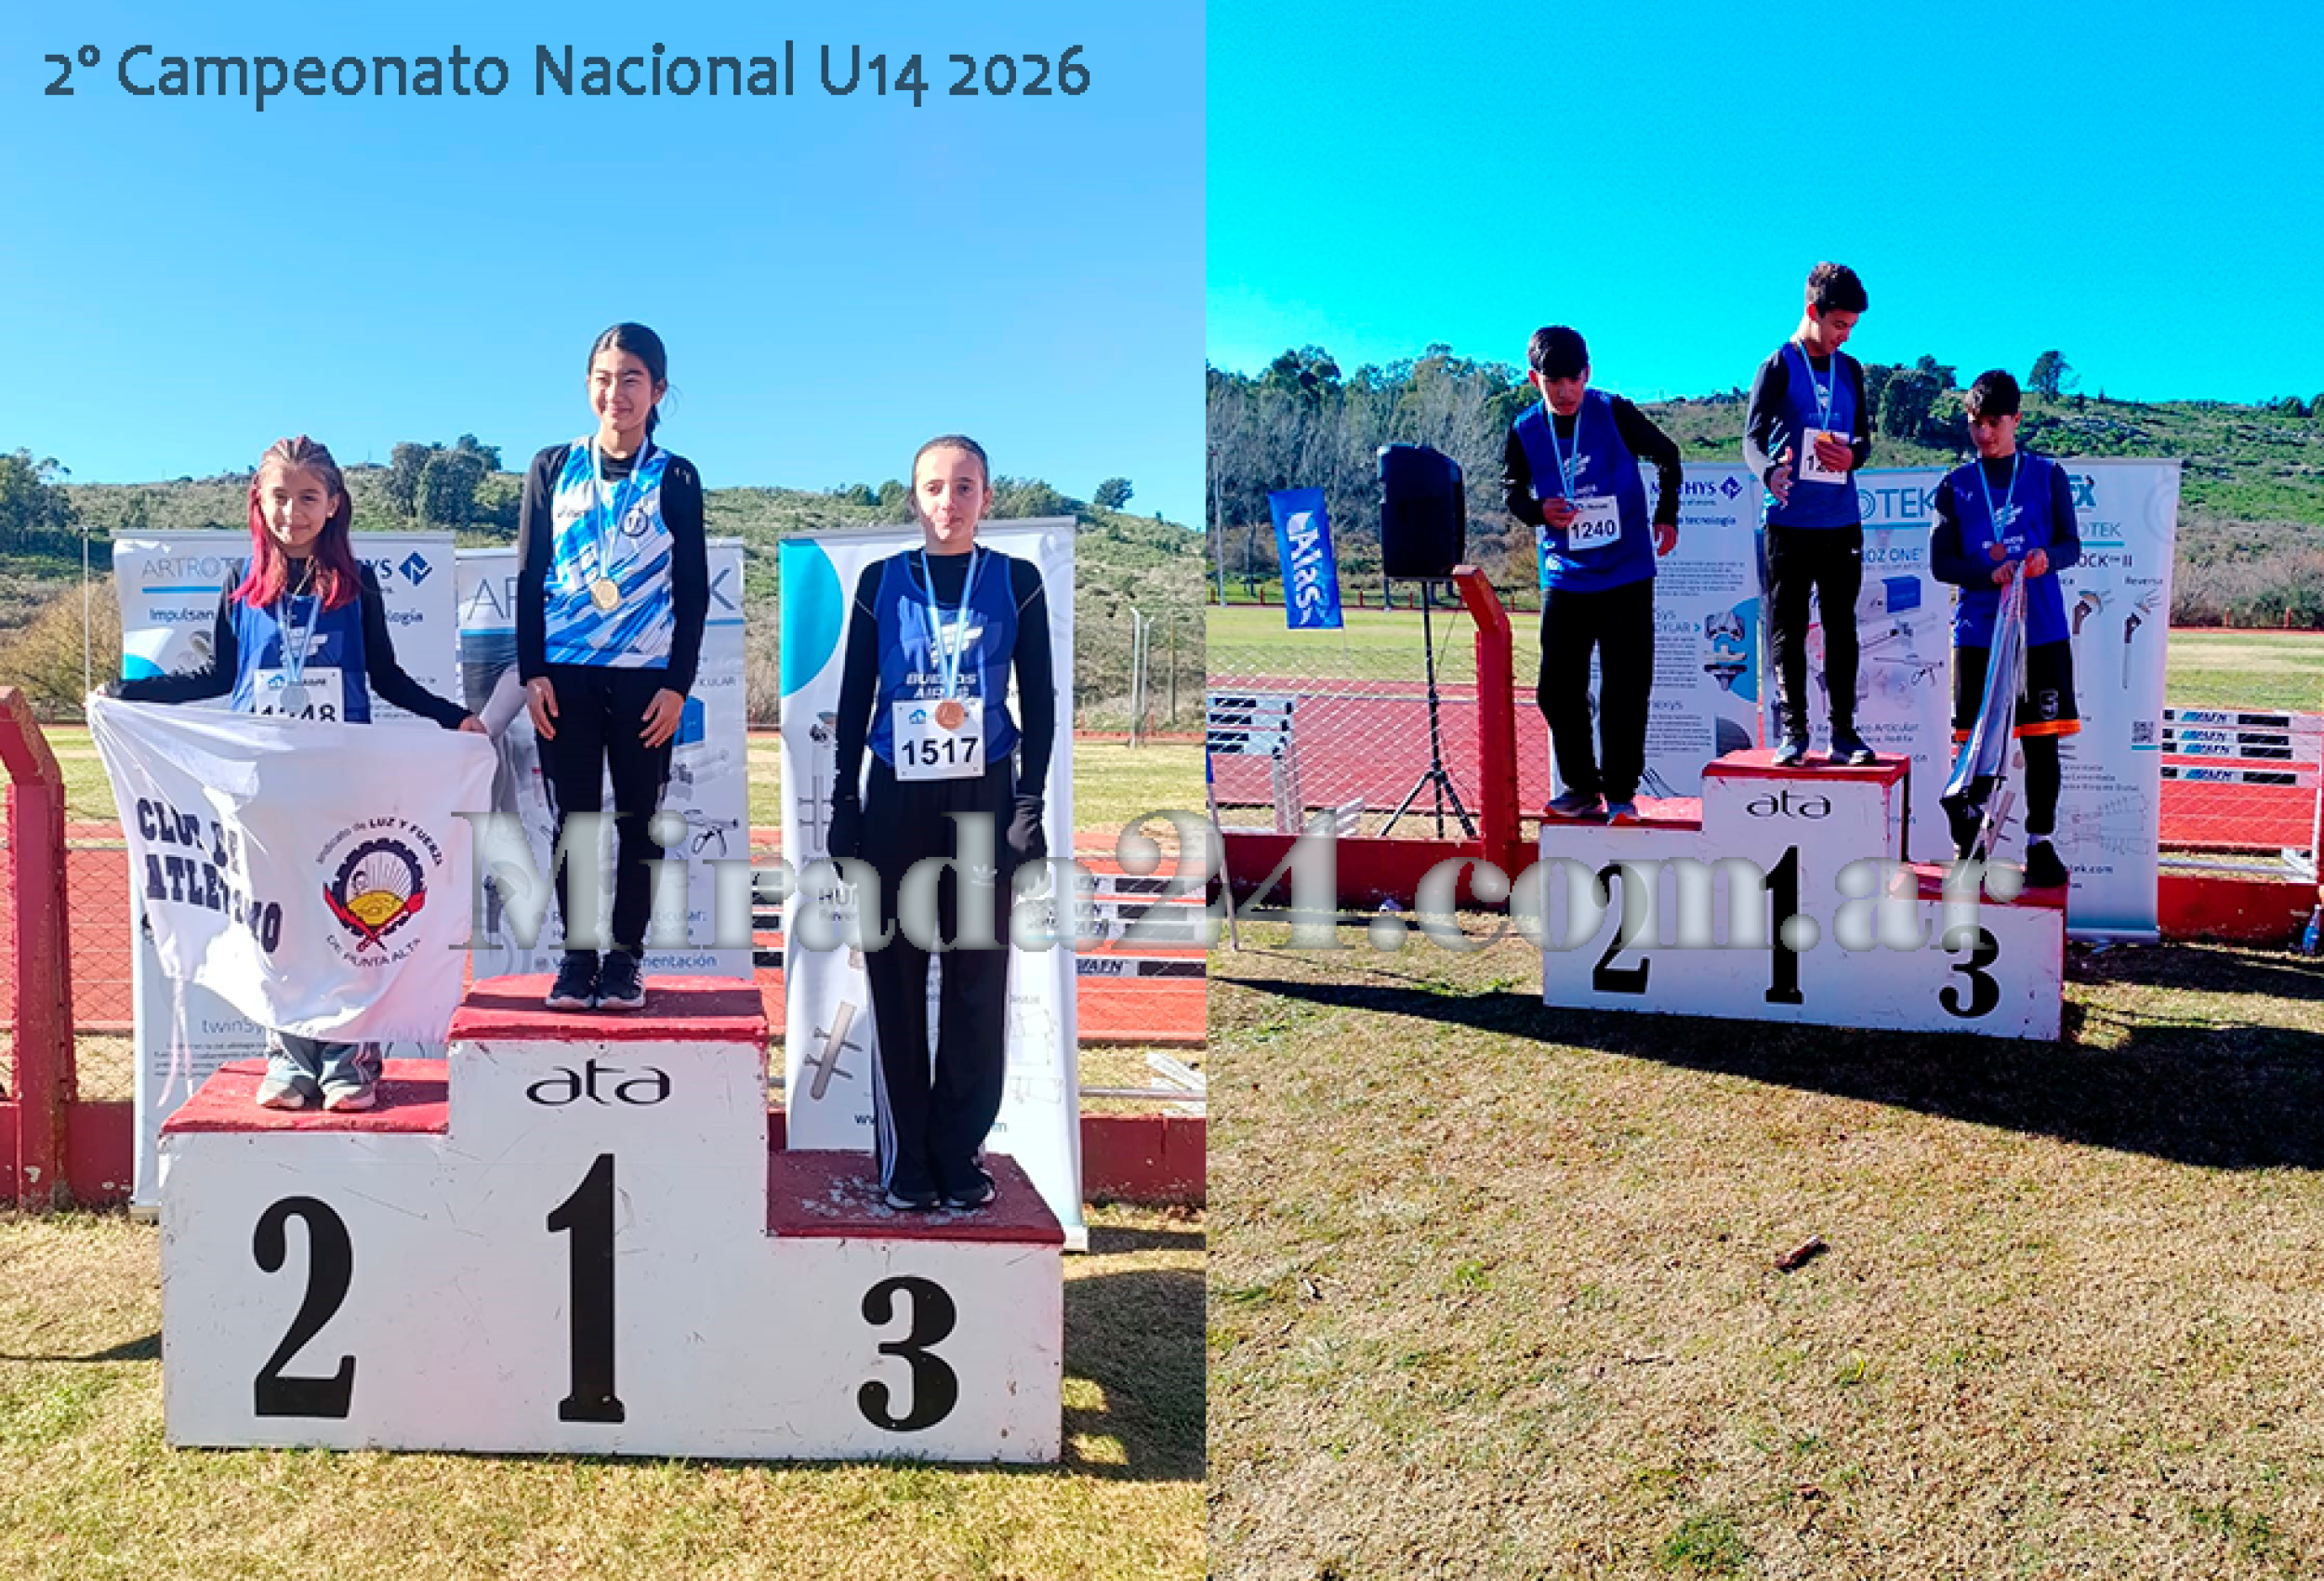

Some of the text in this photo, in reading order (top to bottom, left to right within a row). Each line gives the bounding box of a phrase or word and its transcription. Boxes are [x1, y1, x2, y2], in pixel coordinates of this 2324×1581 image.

[1571, 519, 1616, 540] 1240
[905, 673, 977, 685] BUOS
[902, 737, 979, 766] 1517
[145, 854, 283, 955] ATLEMO
[1592, 863, 1650, 995] 2
[1760, 845, 1803, 1005] 1
[1938, 927, 2000, 1019] 3
[253, 1195, 357, 1418] 2
[548, 1153, 626, 1423] 1
[857, 1276, 957, 1432] 3
